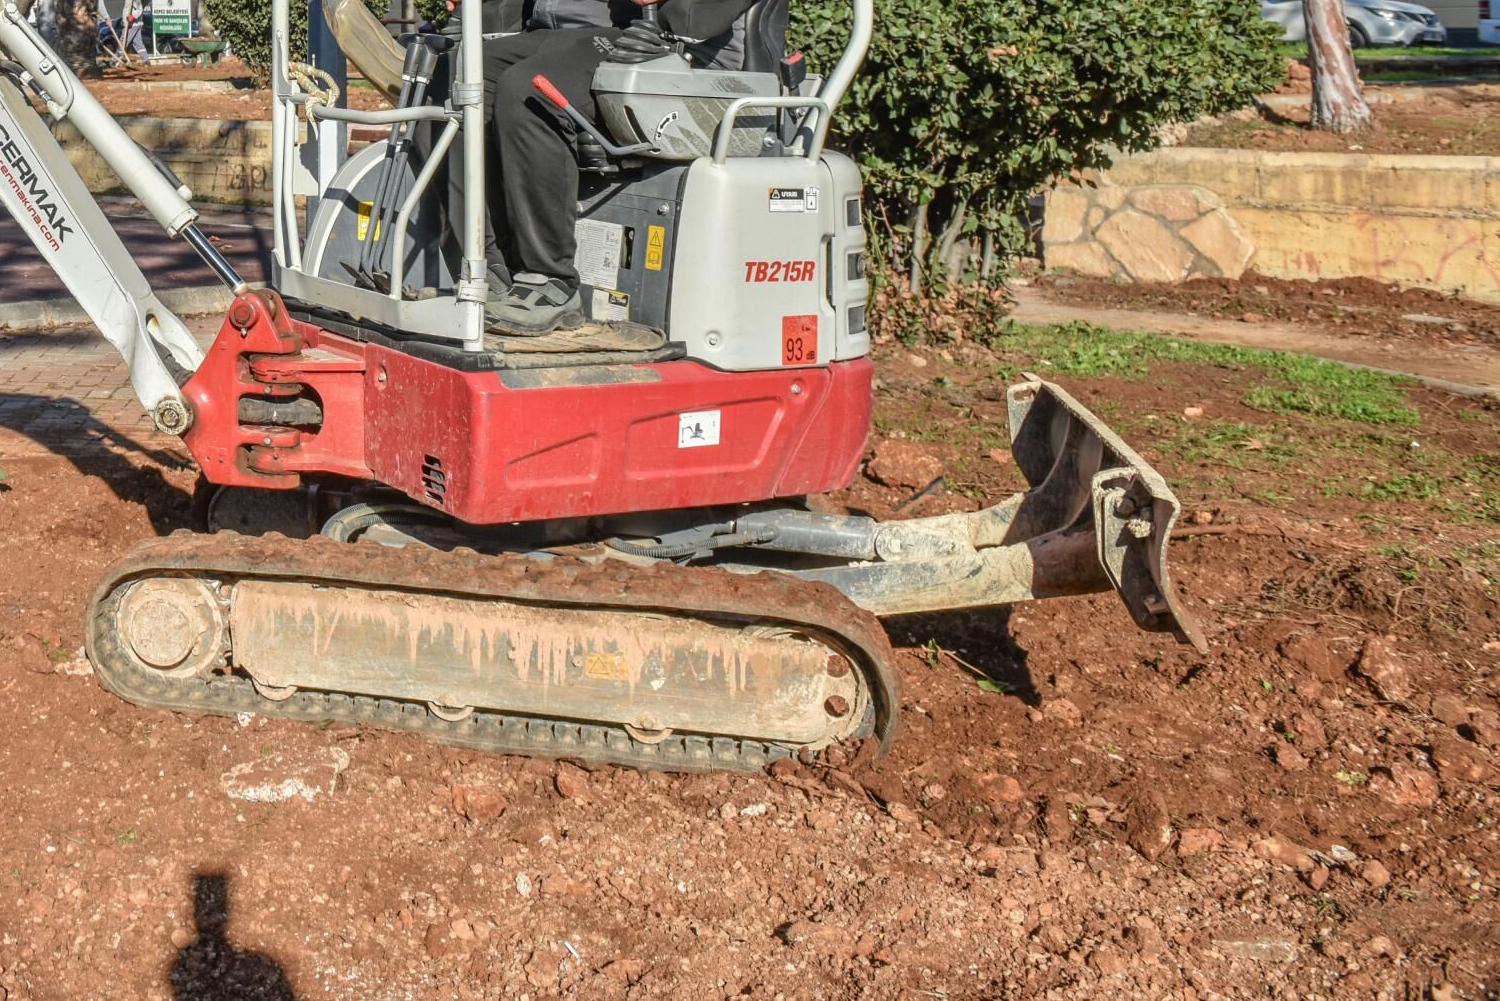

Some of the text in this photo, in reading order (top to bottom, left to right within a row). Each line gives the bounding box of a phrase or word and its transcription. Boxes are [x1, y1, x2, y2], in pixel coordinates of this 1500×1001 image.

[745, 261, 815, 283] TB215R
[786, 337, 815, 361] 93 dB
